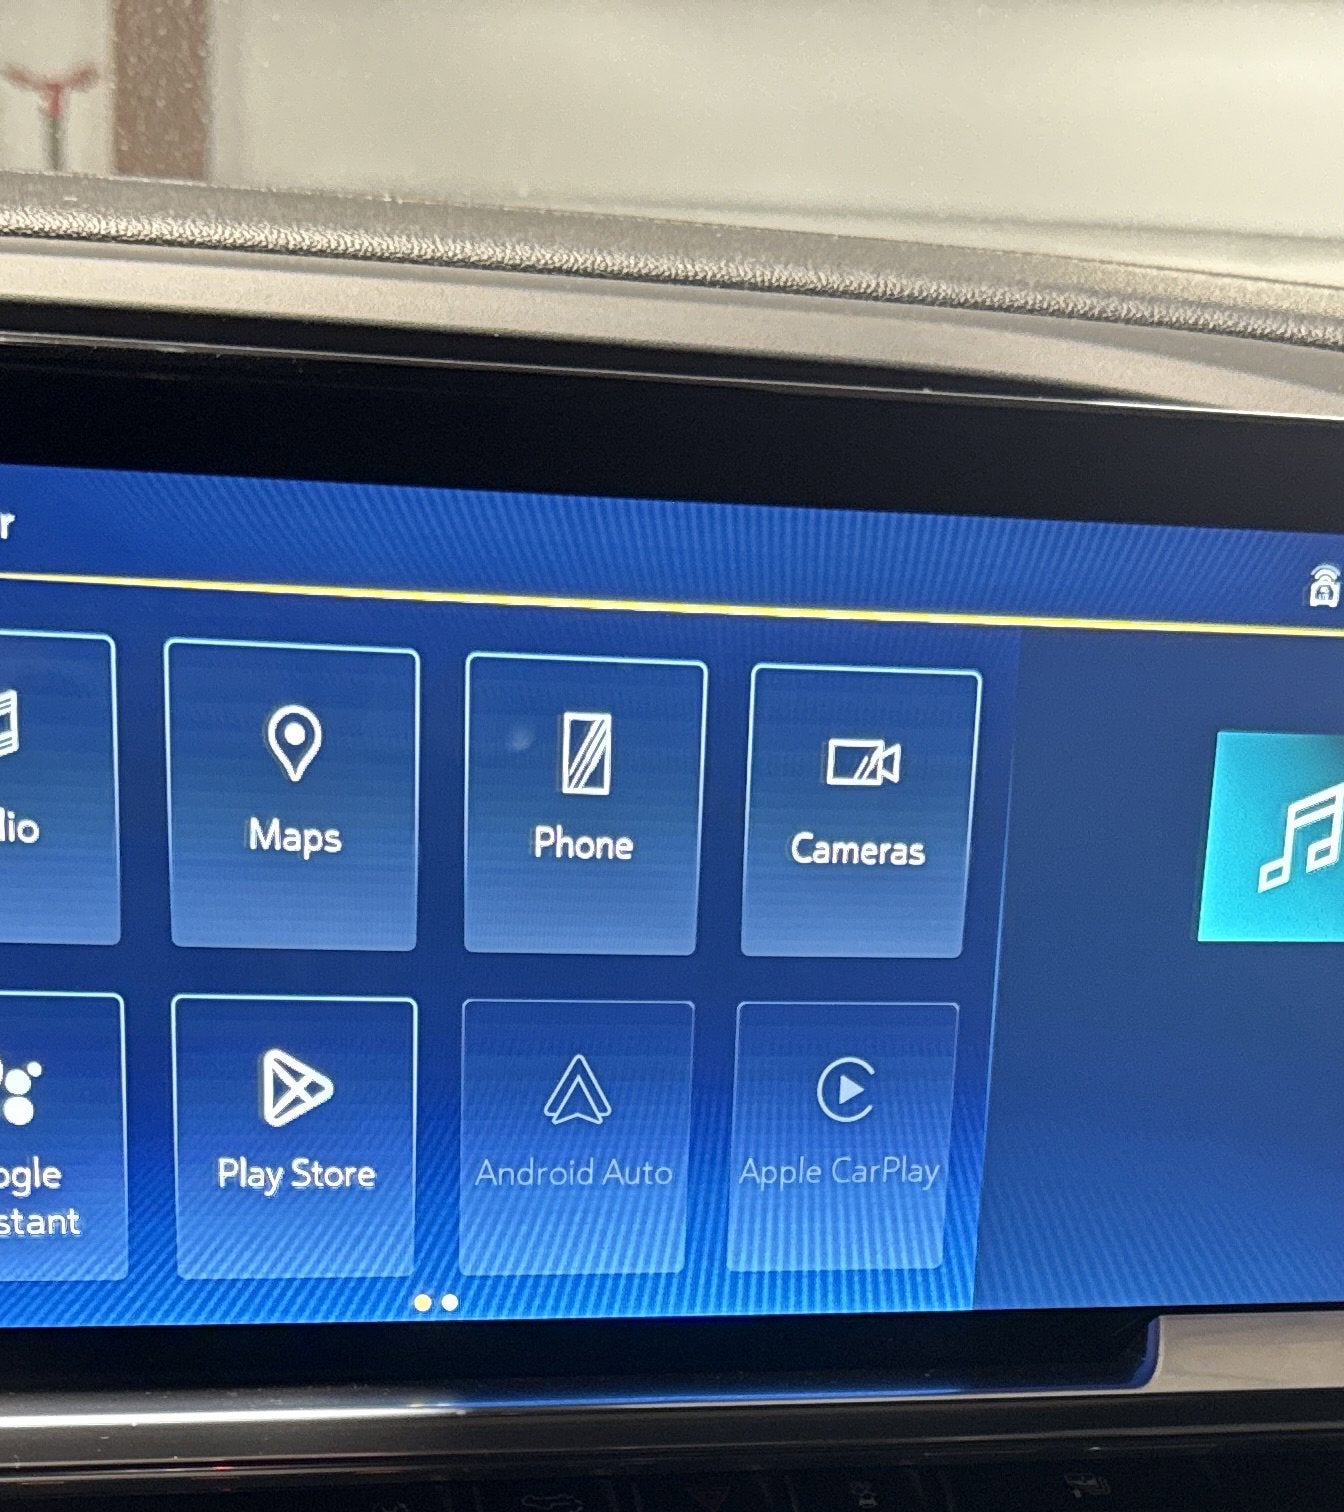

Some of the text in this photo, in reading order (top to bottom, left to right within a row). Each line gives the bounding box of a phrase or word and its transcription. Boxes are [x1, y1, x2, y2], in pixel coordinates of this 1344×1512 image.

[249, 817, 343, 861] Maps
[533, 824, 635, 861] Phone
[789, 830, 927, 867] Cameras
[217, 1156, 377, 1198] Play Store
[474, 1156, 674, 1187] Android Auto
[738, 1155, 941, 1192] Apple CarPlay
